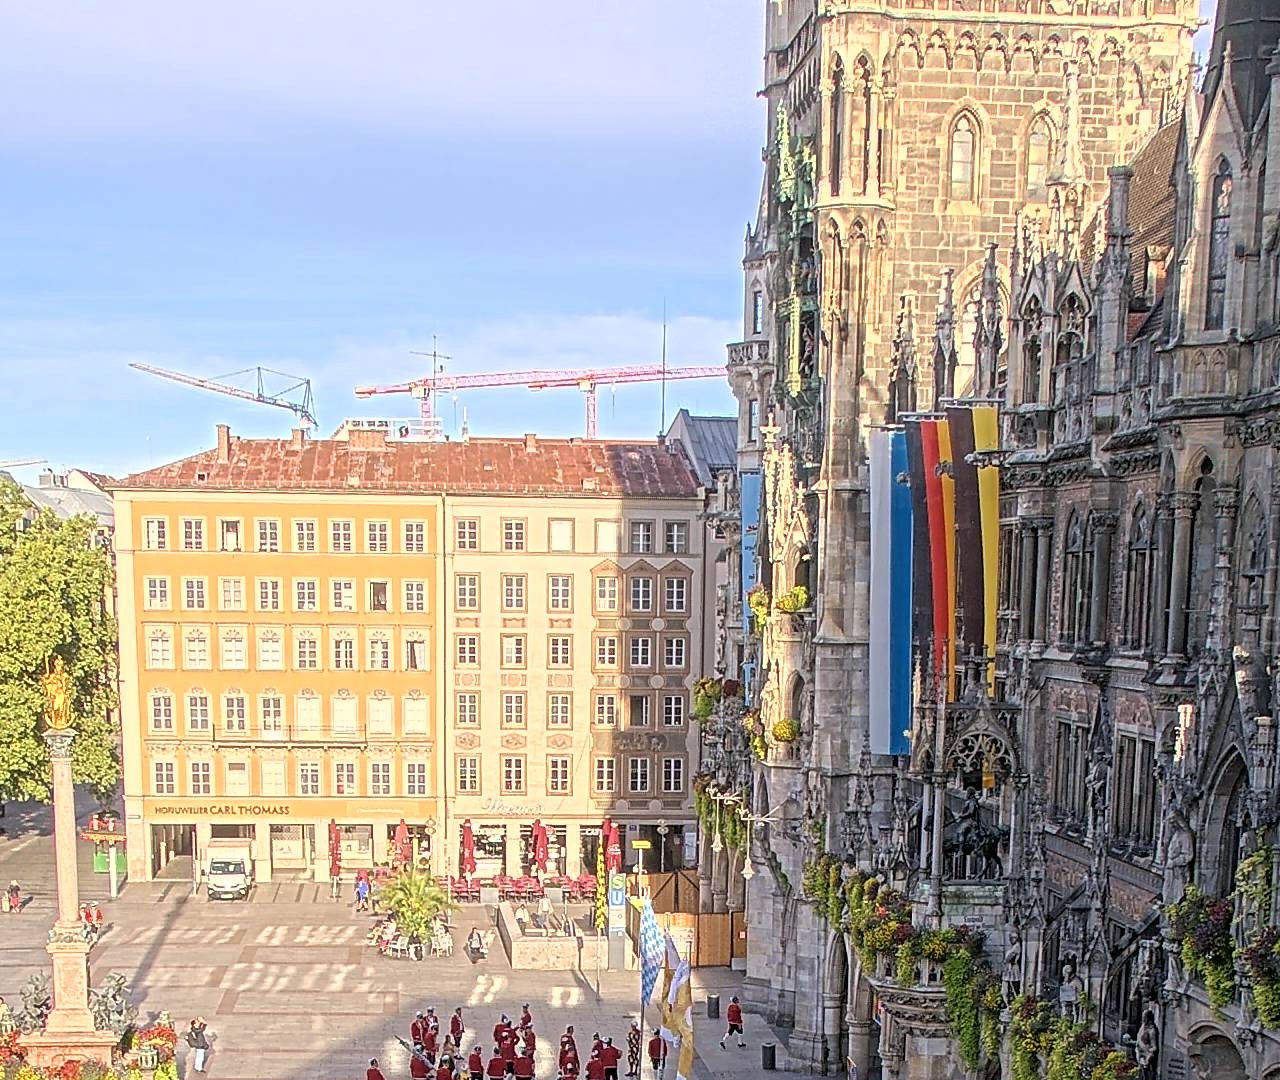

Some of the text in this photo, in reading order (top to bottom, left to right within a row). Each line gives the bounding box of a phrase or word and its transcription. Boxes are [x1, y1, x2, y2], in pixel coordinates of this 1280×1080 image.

[209, 805, 236, 815] CARL
[238, 805, 290, 815] THOMASS
[611, 876, 624, 890] S
[611, 891, 624, 905] U
